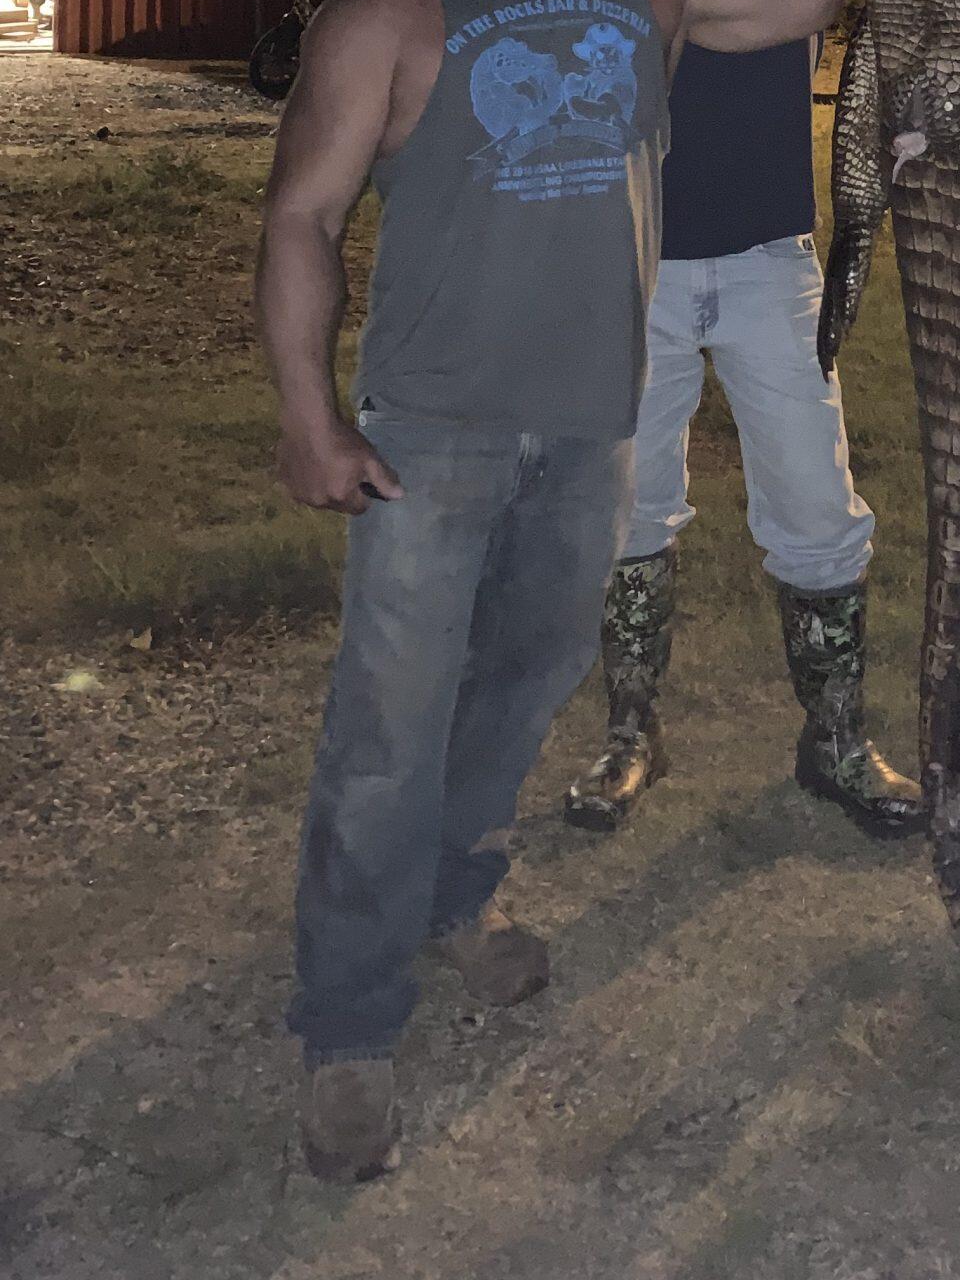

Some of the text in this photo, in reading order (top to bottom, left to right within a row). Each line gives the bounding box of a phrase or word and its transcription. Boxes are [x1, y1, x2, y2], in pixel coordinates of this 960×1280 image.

[446, 30, 468, 54] ON
[463, 14, 495, 38] THE
[494, 0, 544, 30] ROCKS
